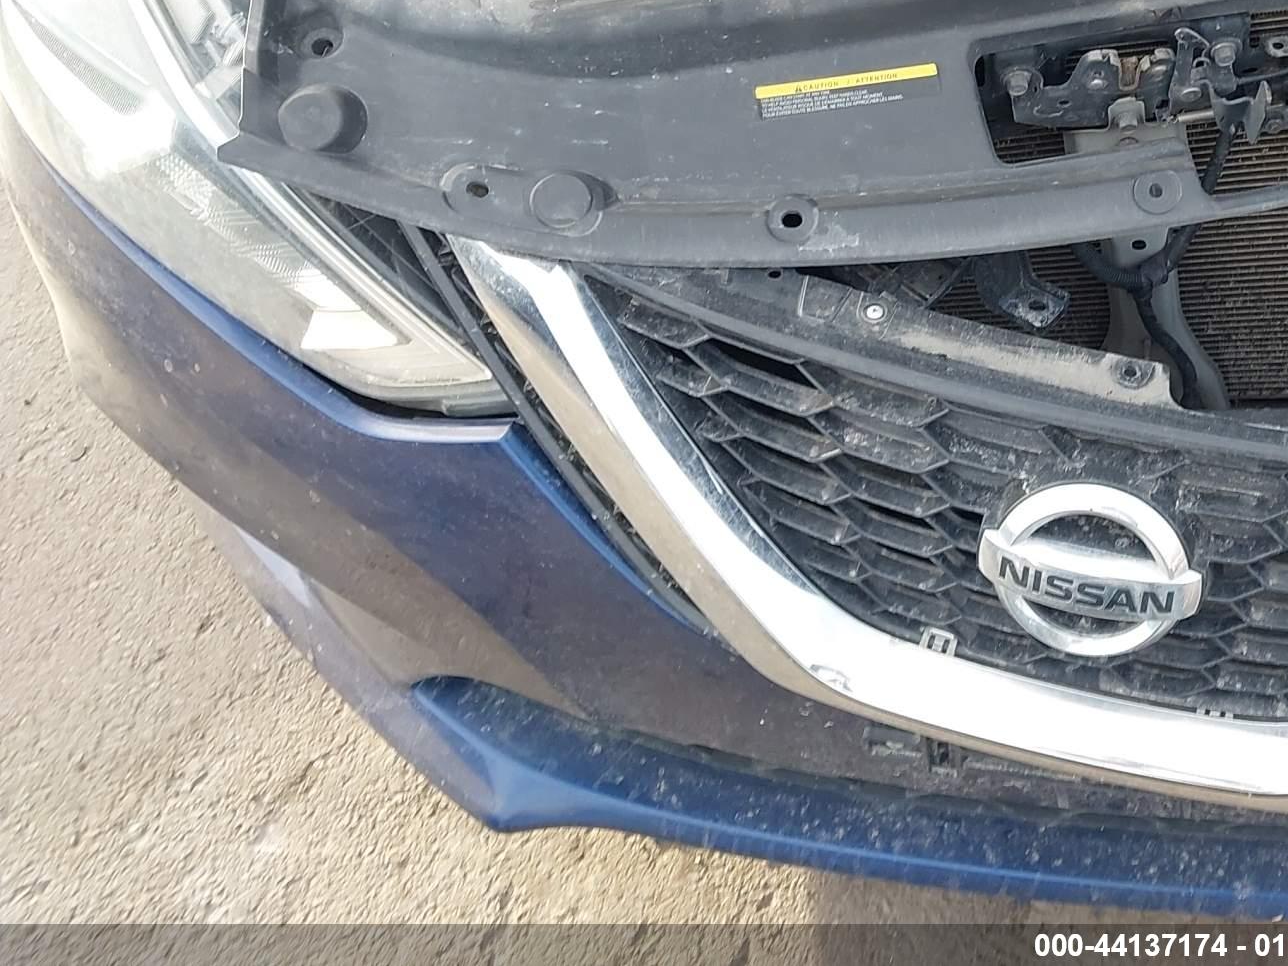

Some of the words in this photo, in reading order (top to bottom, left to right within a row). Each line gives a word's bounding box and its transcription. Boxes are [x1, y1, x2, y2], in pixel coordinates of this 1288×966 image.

[803, 81, 839, 91] CAUTION
[855, 73, 898, 85] ATTENTION
[999, 555, 1174, 614] NISSAN
